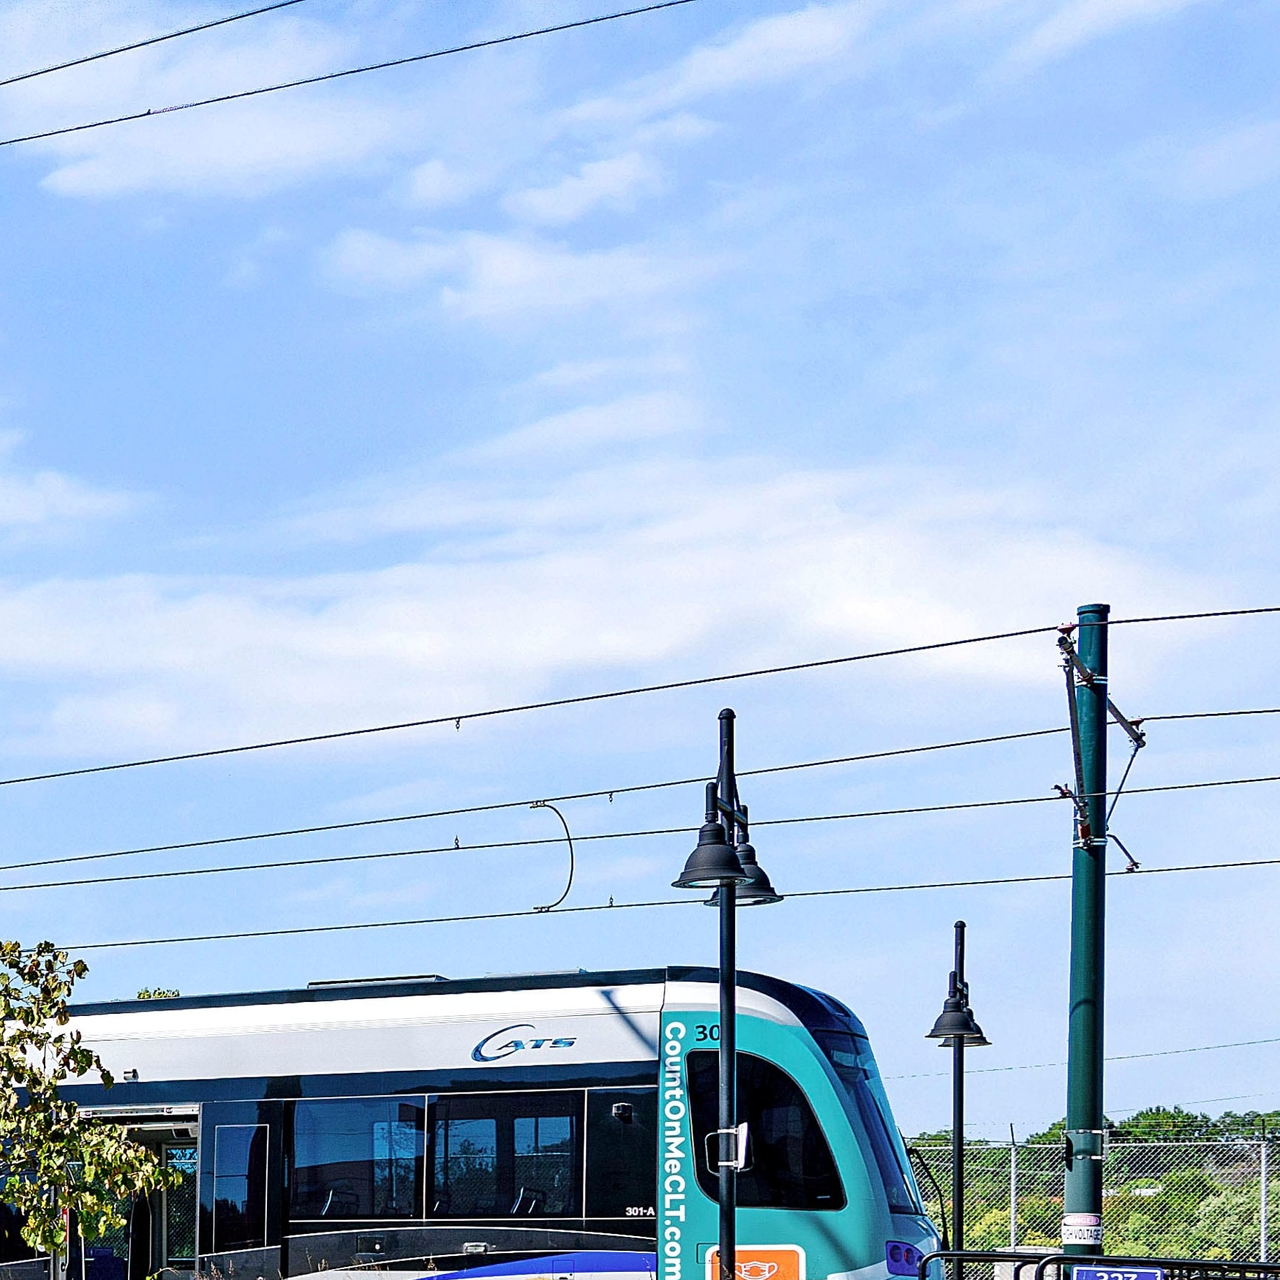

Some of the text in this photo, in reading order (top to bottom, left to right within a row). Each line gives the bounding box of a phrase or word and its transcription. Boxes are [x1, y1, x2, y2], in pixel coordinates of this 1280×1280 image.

[695, 1025, 720, 1042] 30
[471, 1024, 577, 1062] CATS
[664, 1021, 686, 1280] CountOnMeCLT.com
[625, 1206, 656, 1217] 301-A
[1074, 1228, 1102, 1240] VOLTAGE
